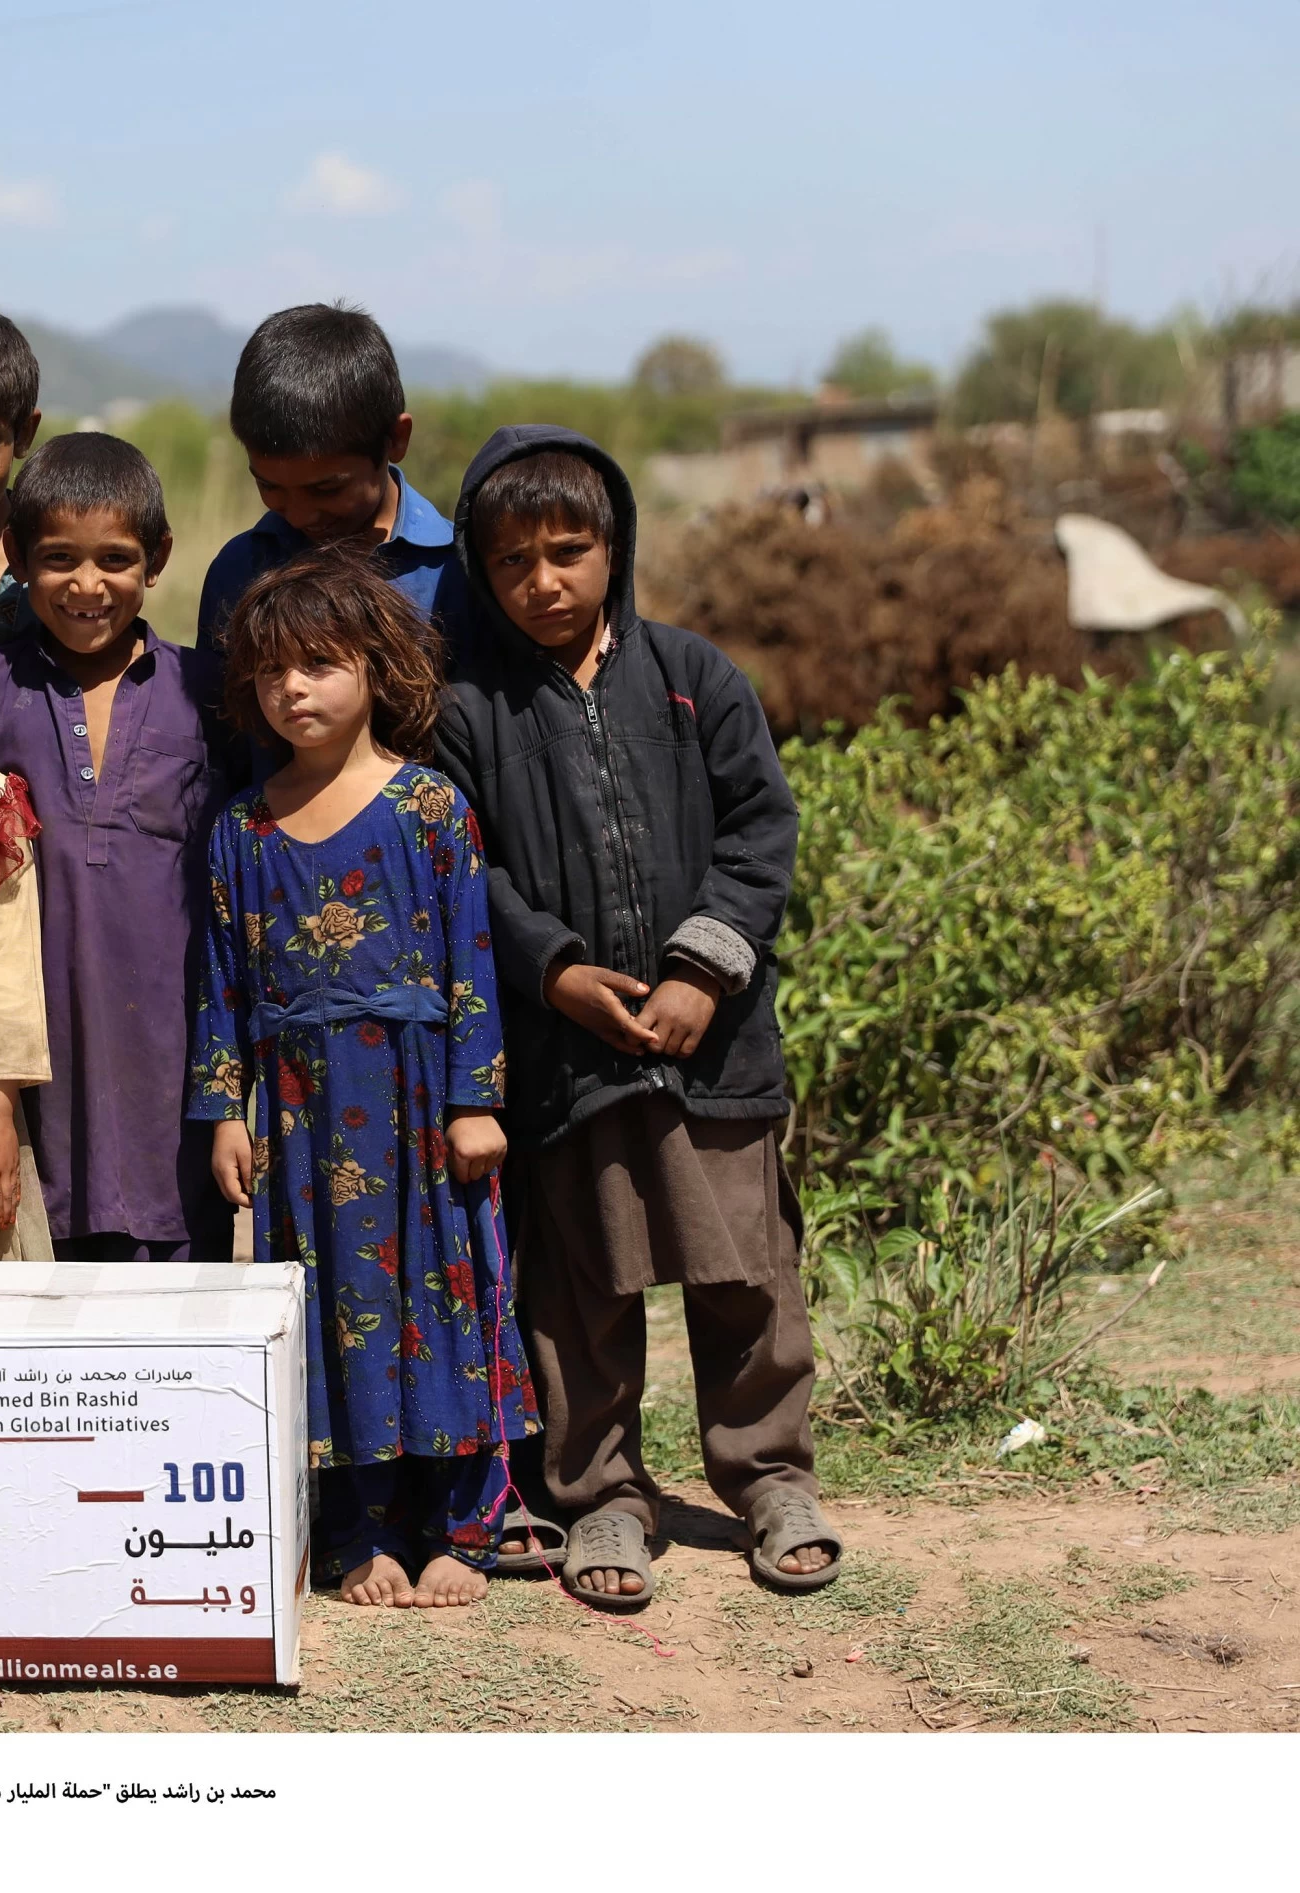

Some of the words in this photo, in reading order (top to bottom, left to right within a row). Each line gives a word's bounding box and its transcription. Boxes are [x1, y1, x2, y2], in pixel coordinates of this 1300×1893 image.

[15, 1369, 48, 1385] راشد
[56, 1371, 72, 1384] بن
[81, 1371, 127, 1381] محمد
[135, 1368, 192, 1384] مبادرات
[41, 1391, 69, 1408] Bin
[76, 1390, 138, 1407] Rashid
[10, 1416, 70, 1433] Global
[77, 1415, 170, 1433] Initiatives
[164, 1461, 245, 1503] 100
